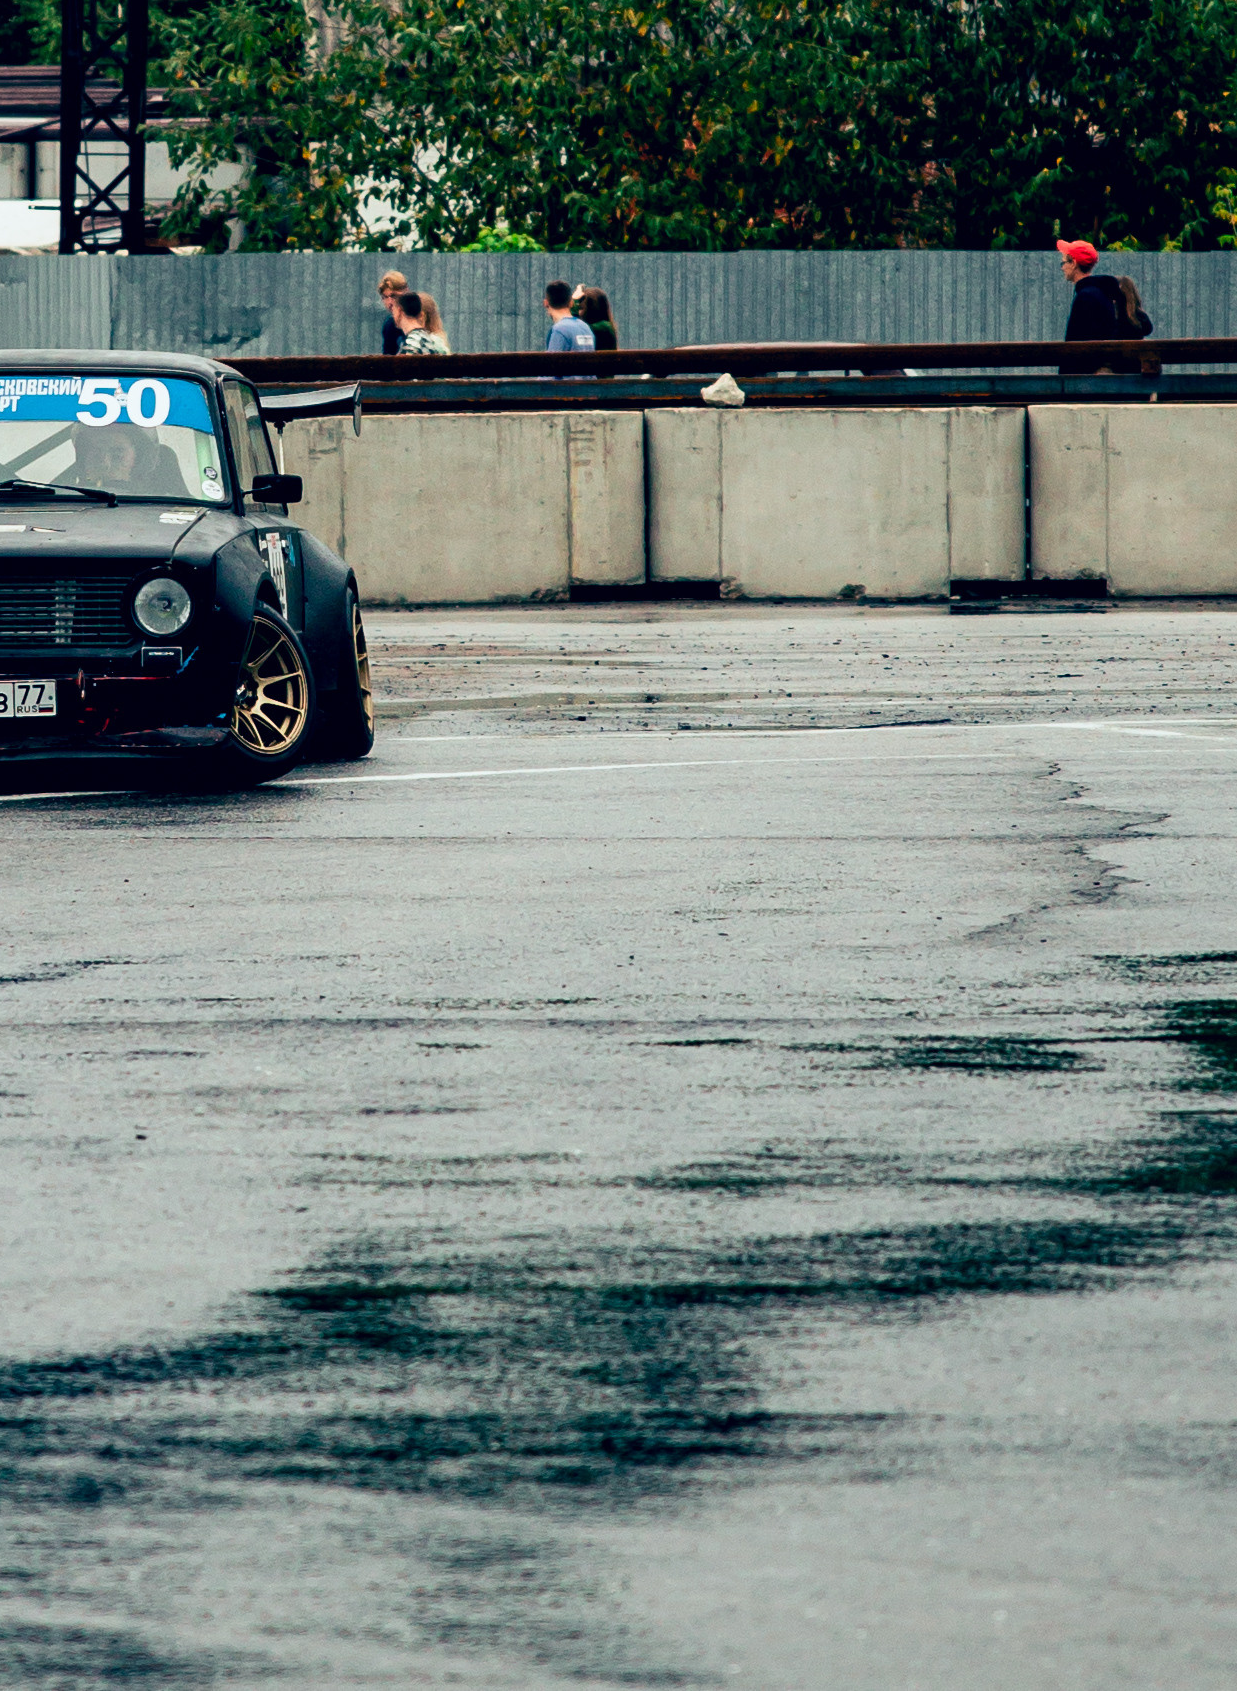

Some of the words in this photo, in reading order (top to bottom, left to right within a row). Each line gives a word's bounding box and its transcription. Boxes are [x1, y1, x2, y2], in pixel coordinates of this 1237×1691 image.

[75, 378, 171, 428] 50
[17, 684, 46, 706] 77
[16, 705, 38, 714] RUS
